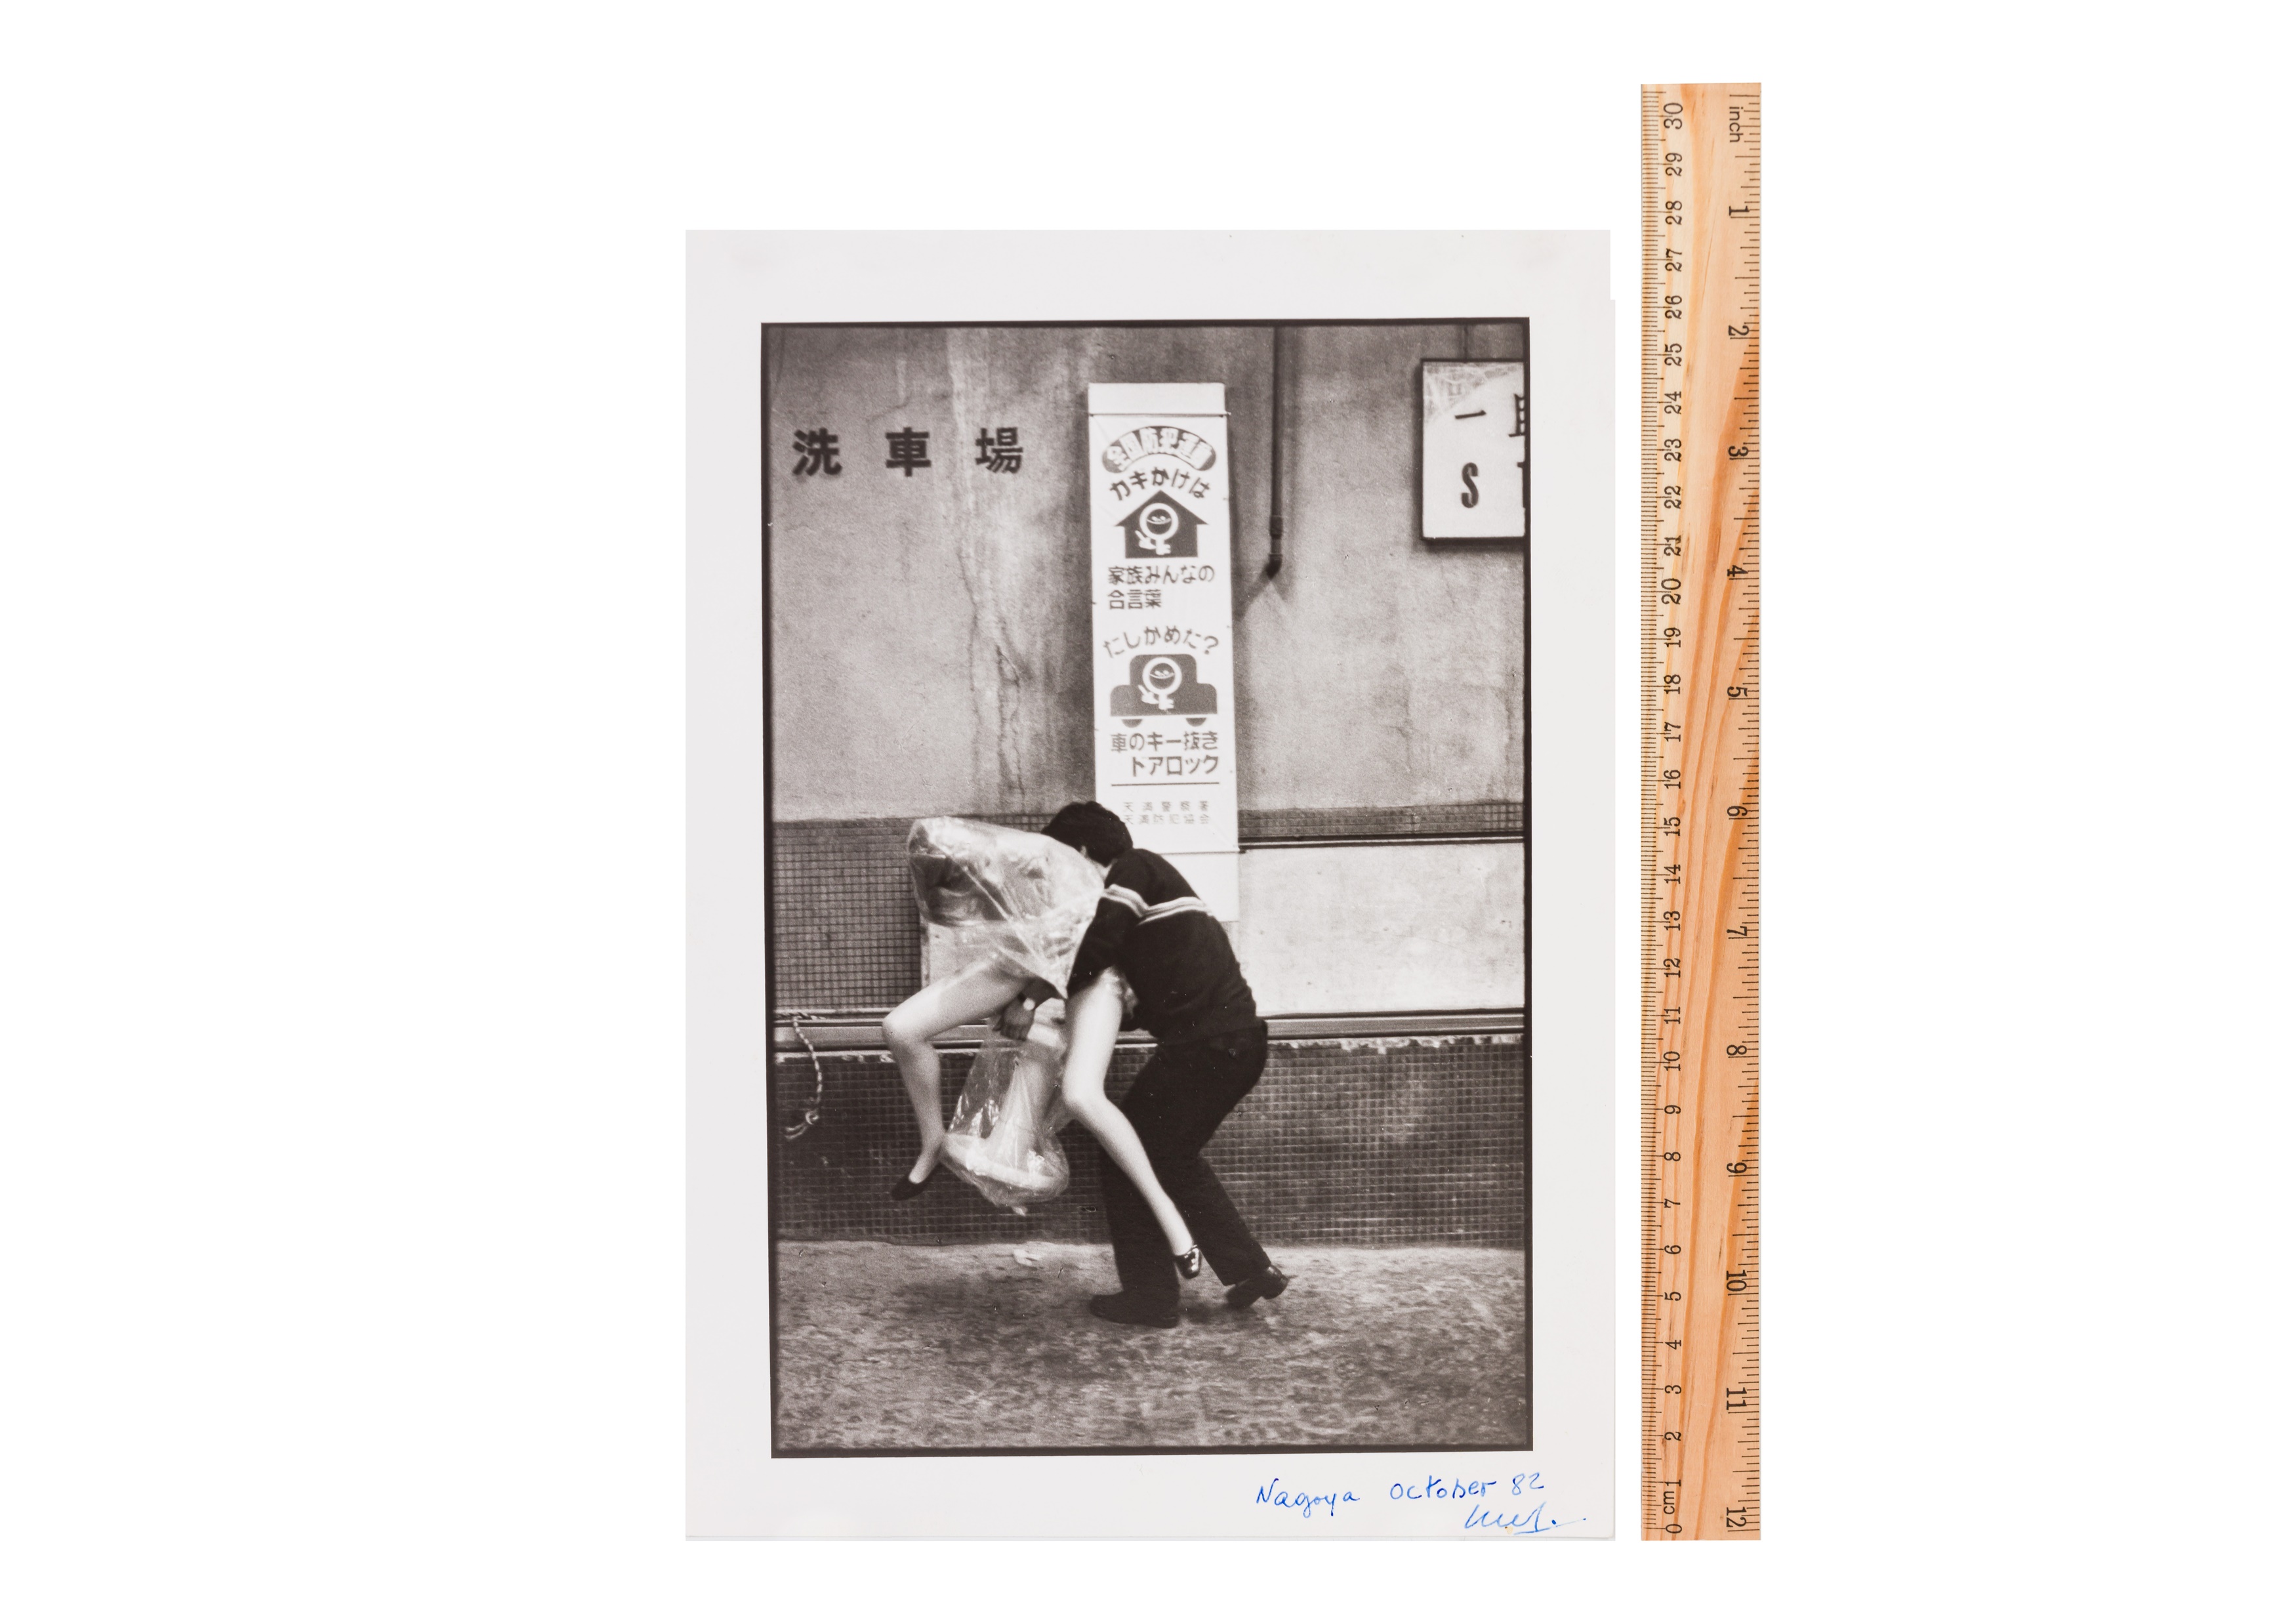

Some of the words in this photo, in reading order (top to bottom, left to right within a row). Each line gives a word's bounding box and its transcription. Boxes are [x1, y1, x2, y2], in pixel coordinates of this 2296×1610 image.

[1663, 102, 1683, 130] 30
[1729, 106, 1744, 143] inch
[1665, 152, 1683, 176] 29
[1665, 200, 1683, 225] 28
[1729, 205, 1750, 216] 1
[1665, 247, 1683, 272] 27
[1664, 295, 1683, 320] 26
[1728, 325, 1750, 337] 2
[1664, 343, 1682, 366] 25
[1664, 391, 1681, 415] 24
[792, 426, 1023, 477] 洗車場
[1664, 438, 1681, 461] 23
[1728, 445, 1748, 457] 3
[1664, 485, 1681, 509] 22
[1664, 535, 1681, 556] 21
[1108, 565, 1215, 585] 家族みんなの
[1727, 565, 1748, 577] 4
[1108, 589, 1162, 609] 合言葉
[1661, 577, 1681, 606] 20
[1664, 627, 1681, 648] 19
[1664, 674, 1681, 694] 18
[1727, 686, 1748, 697] 5
[1111, 731, 1218, 753] 車のキー抜き
[1664, 722, 1681, 743] 17
[1664, 769, 1681, 789] 16
[1727, 805, 1748, 817] 6
[1664, 817, 1681, 837] 15
[1664, 864, 1681, 884] 14
[1664, 911, 1681, 931] 13
[1727, 926, 1748, 937] 7
[1664, 958, 1681, 978] 12
[1664, 1006, 1681, 1024] 11
[1727, 1044, 1748, 1056] 8
[1663, 1051, 1681, 1071] 10
[1664, 1104, 1681, 1115] 9
[1664, 1151, 1681, 1162] 8
[1727, 1162, 1748, 1174] 9
[1664, 1199, 1681, 1208] 7
[1664, 1245, 1681, 1254] 6
[1727, 1269, 1747, 1292] 10
[1664, 1291, 1681, 1301] 5
[1665, 1339, 1681, 1350] 4
[1665, 1384, 1681, 1395] 3
[1727, 1387, 1747, 1410] 11
[1664, 1431, 1681, 1441] 2
[1665, 1478, 1681, 1487] 1
[1256, 1477, 1360, 1517] Nagoya
[1511, 1472, 1545, 1496] 82
[1664, 1491, 1675, 1515] cm
[1727, 1507, 1747, 1529] 12
[1665, 1523, 1682, 1534] 0
